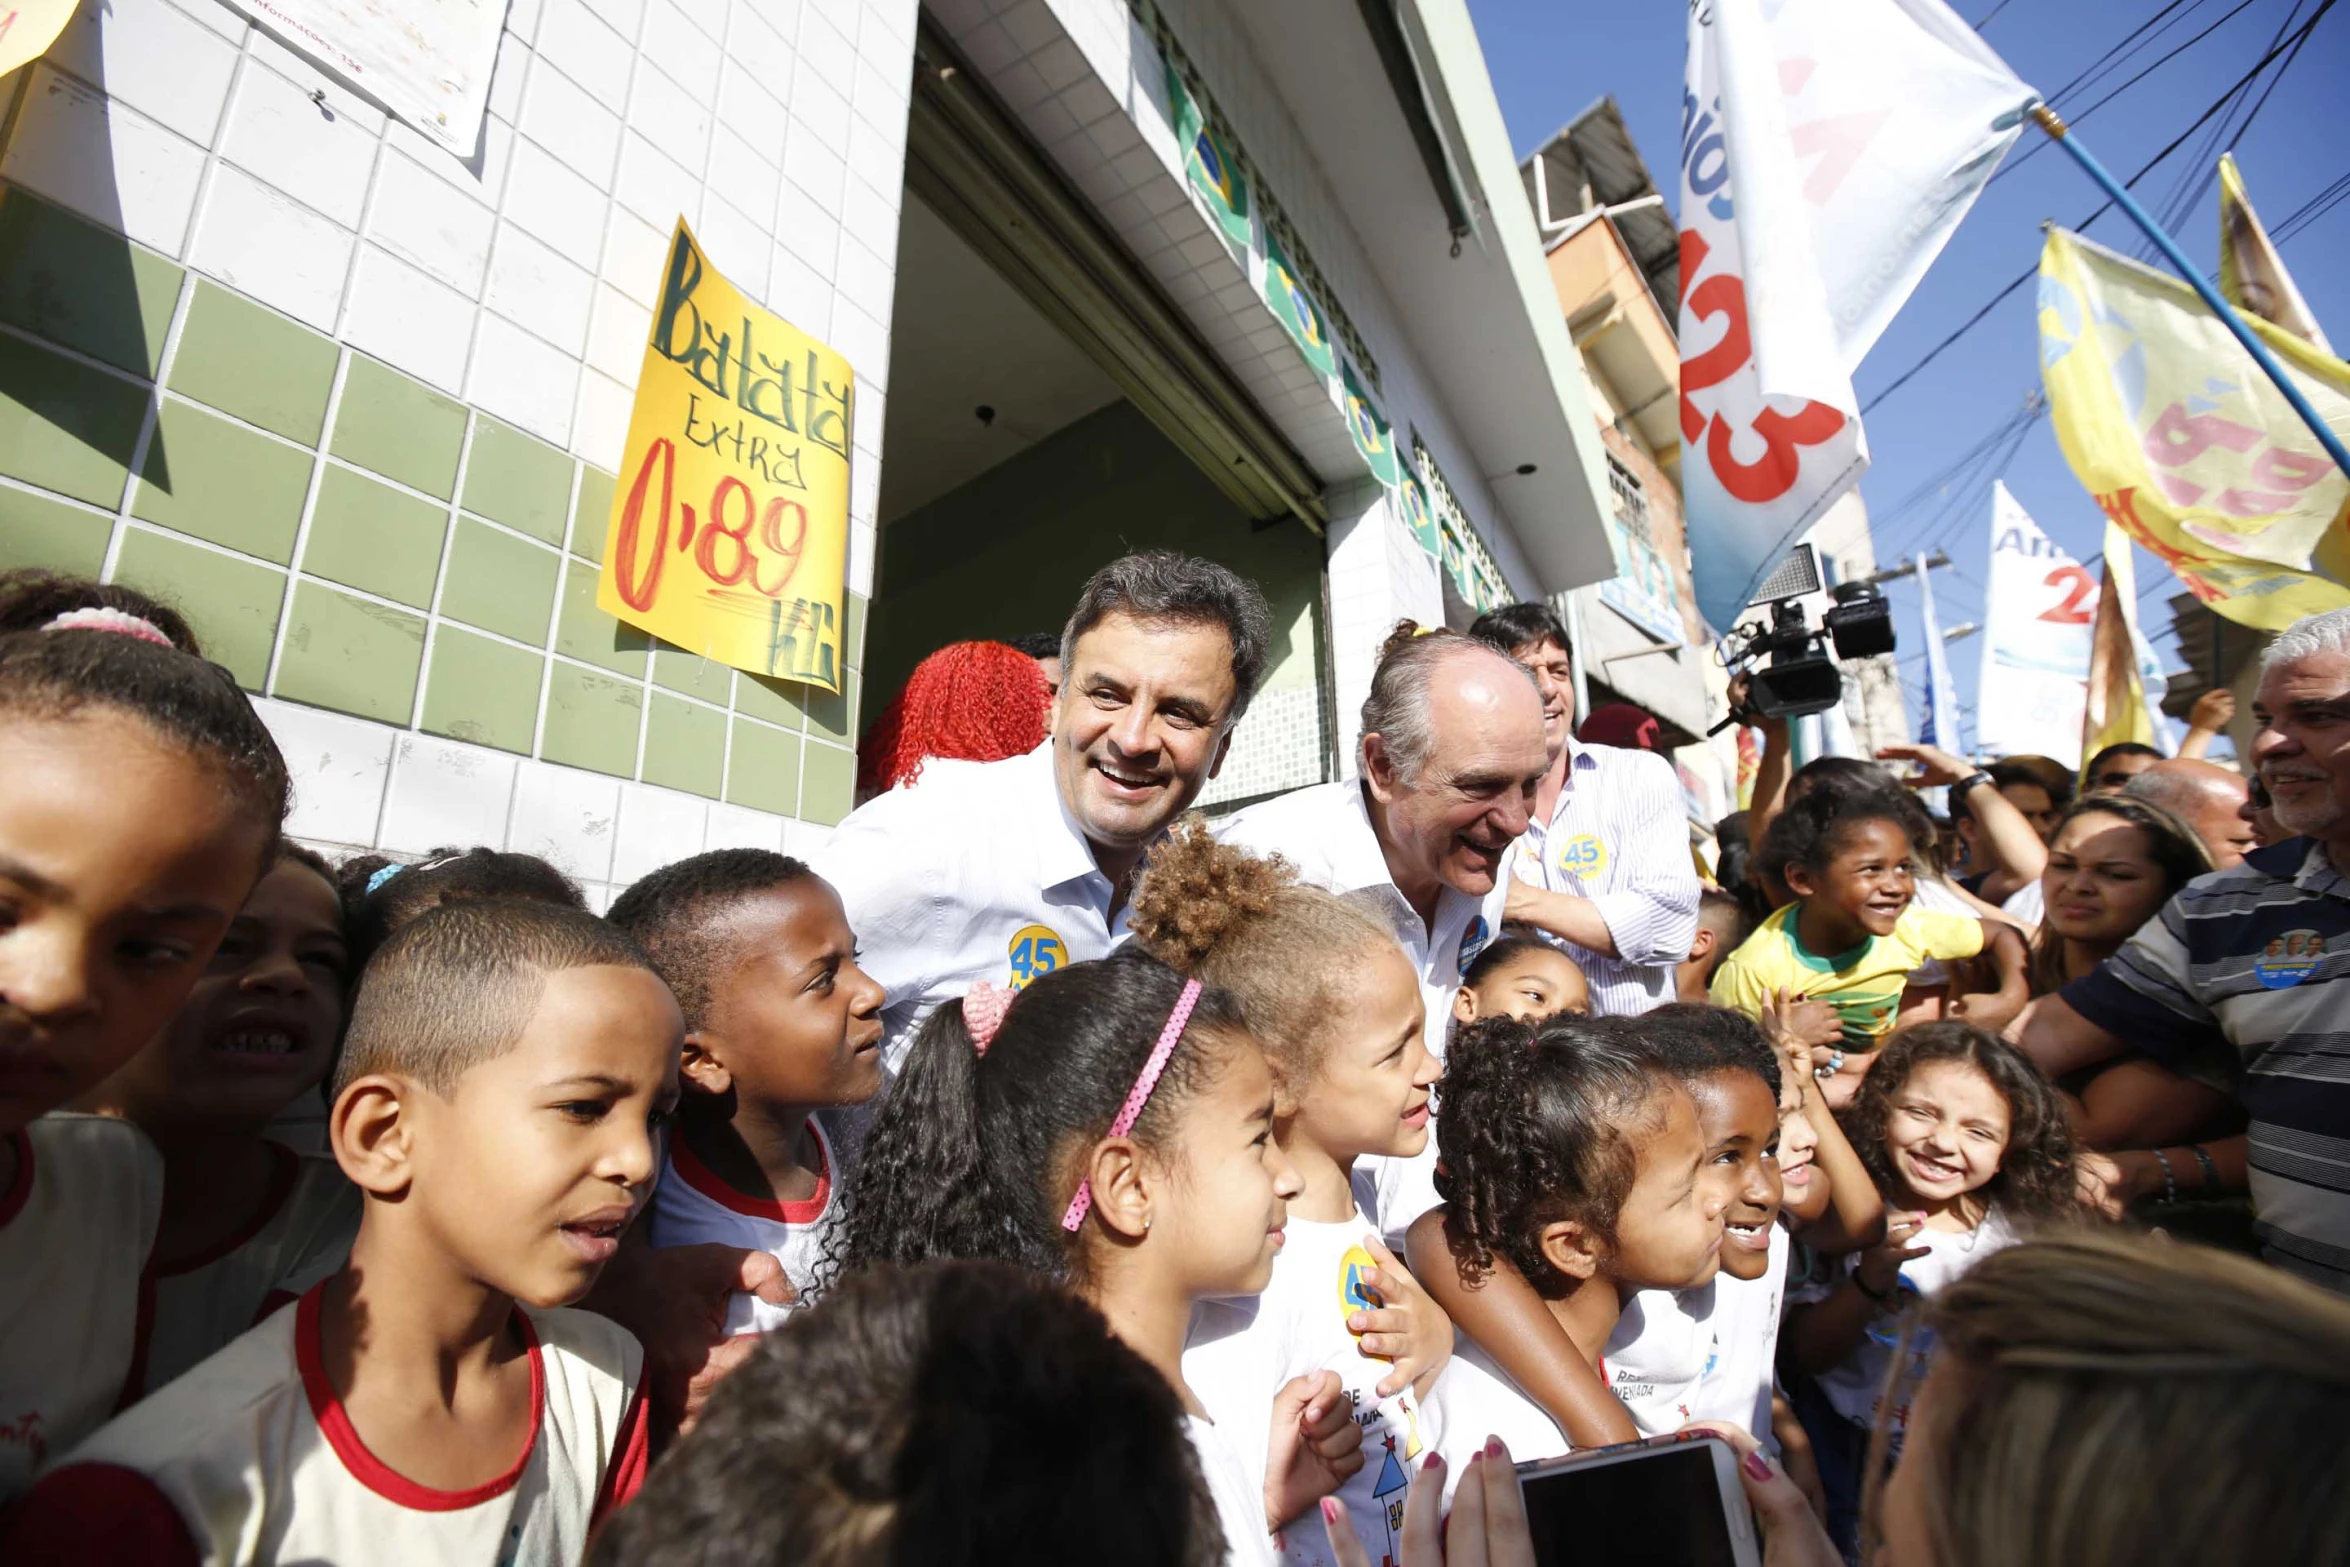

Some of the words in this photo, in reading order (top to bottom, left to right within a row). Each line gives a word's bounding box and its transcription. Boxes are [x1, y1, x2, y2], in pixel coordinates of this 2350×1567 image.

[651, 228, 850, 462] Batata
[1564, 839, 1599, 865] 45
[1010, 937, 1058, 980] 45
